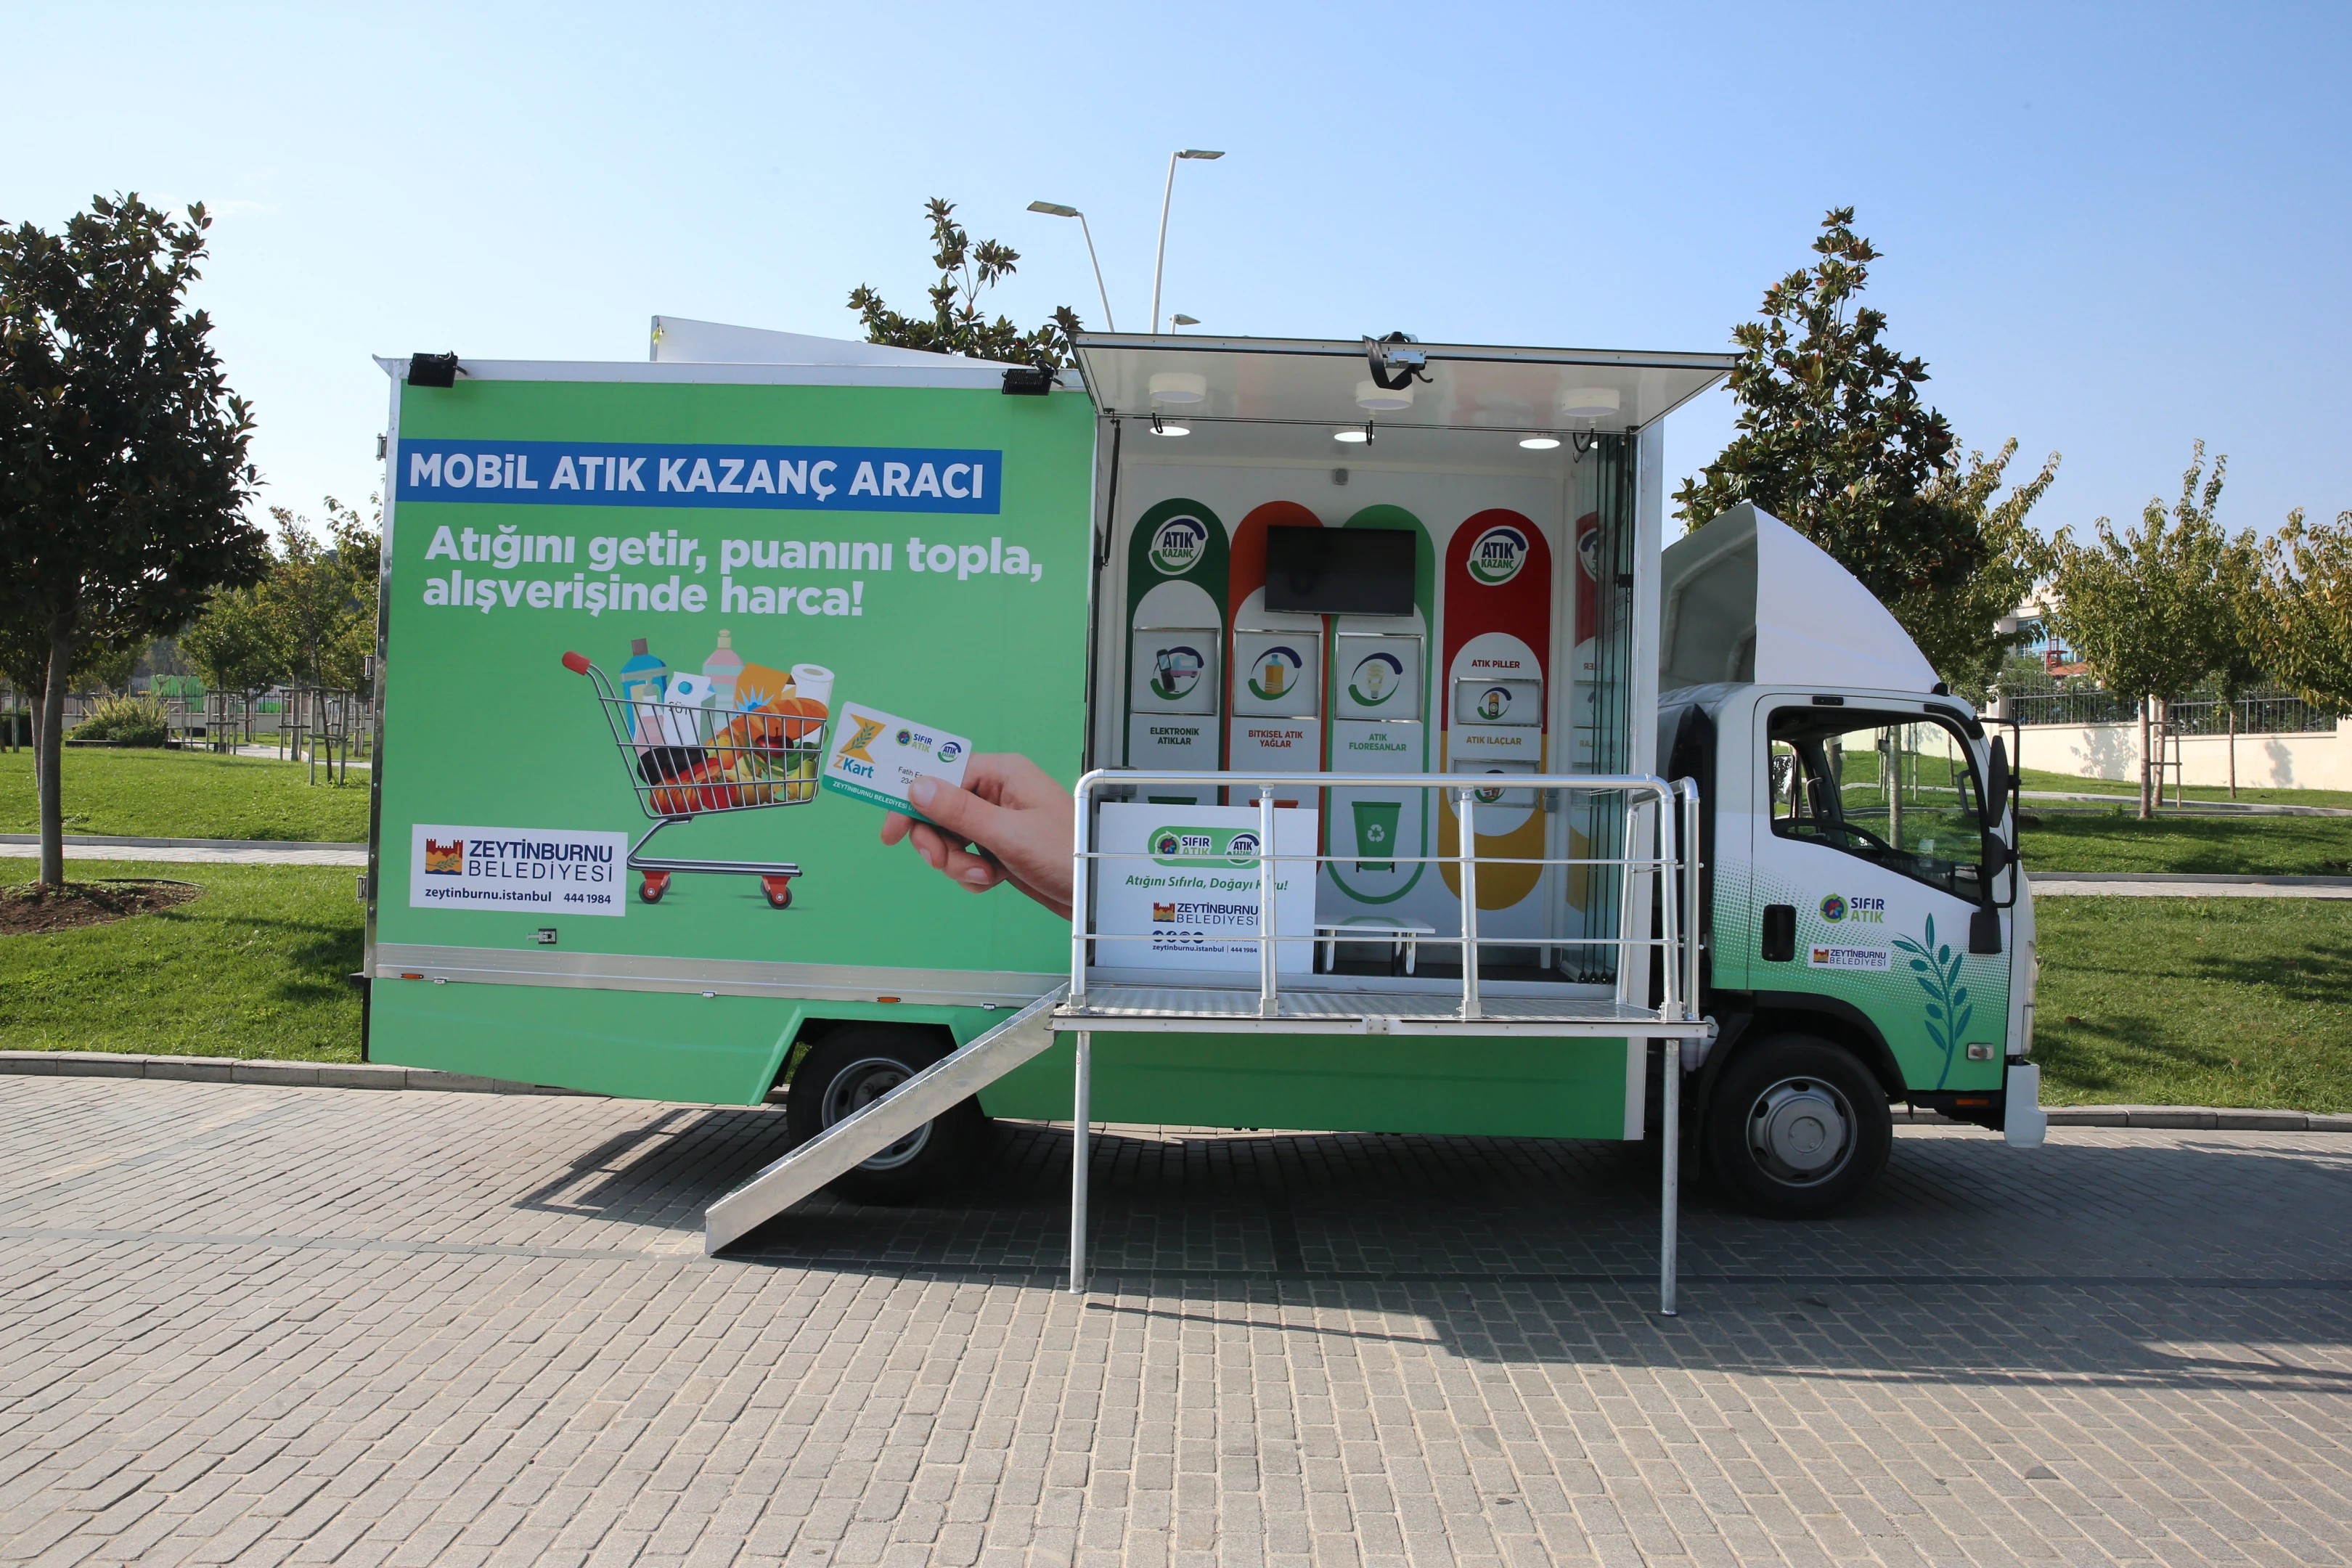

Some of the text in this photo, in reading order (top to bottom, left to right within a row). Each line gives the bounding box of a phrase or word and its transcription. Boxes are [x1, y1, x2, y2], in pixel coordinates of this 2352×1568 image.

[550, 456, 646, 491] ATIK
[658, 458, 838, 502] KAZANÇ
[849, 461, 984, 499] ARACI
[1162, 531, 1194, 548] ATIK
[425, 524, 1042, 583] Atığını getir, puanını topla,
[1162, 548, 1194, 559] KAZANÇ
[1482, 542, 1515, 559] ATIK
[1481, 558, 1514, 570] KAZANÇ
[423, 569, 864, 617] alışverişinde harca!
[1471, 659, 1491, 668] ATIK
[912, 733, 933, 746] SIFIR
[1157, 736, 1191, 746] ATIKLAR
[1285, 730, 1303, 739] ATIK
[912, 740, 931, 753] ATIK
[1259, 738, 1291, 748] YAĞLAR
[1349, 742, 1407, 751] FLORESANLAR
[942, 746, 957, 755] ATIK
[1182, 837, 1210, 846] SIFIR
[1233, 841, 1252, 851] ATIK
[469, 838, 613, 863] ZEYTİNBURNU
[468, 860, 612, 882] BELEDİYESİ
[1125, 875, 1165, 889] Atığını
[1168, 876, 1206, 889] Sıfırla,
[1209, 878, 1253, 891] Doğayı
[425, 887, 552, 902] zeytinburnu.istanbul
[1177, 902, 1258, 915] ZEYTİNBURNU
[1850, 897, 1885, 910] SIFIR
[1177, 913, 1258, 926] BELEDİYESİ
[1850, 910, 1885, 923] ATIK
[1830, 949, 1887, 959] ZEYTİNBURNU
[1829, 957, 1886, 967] BELEDİYESİ
